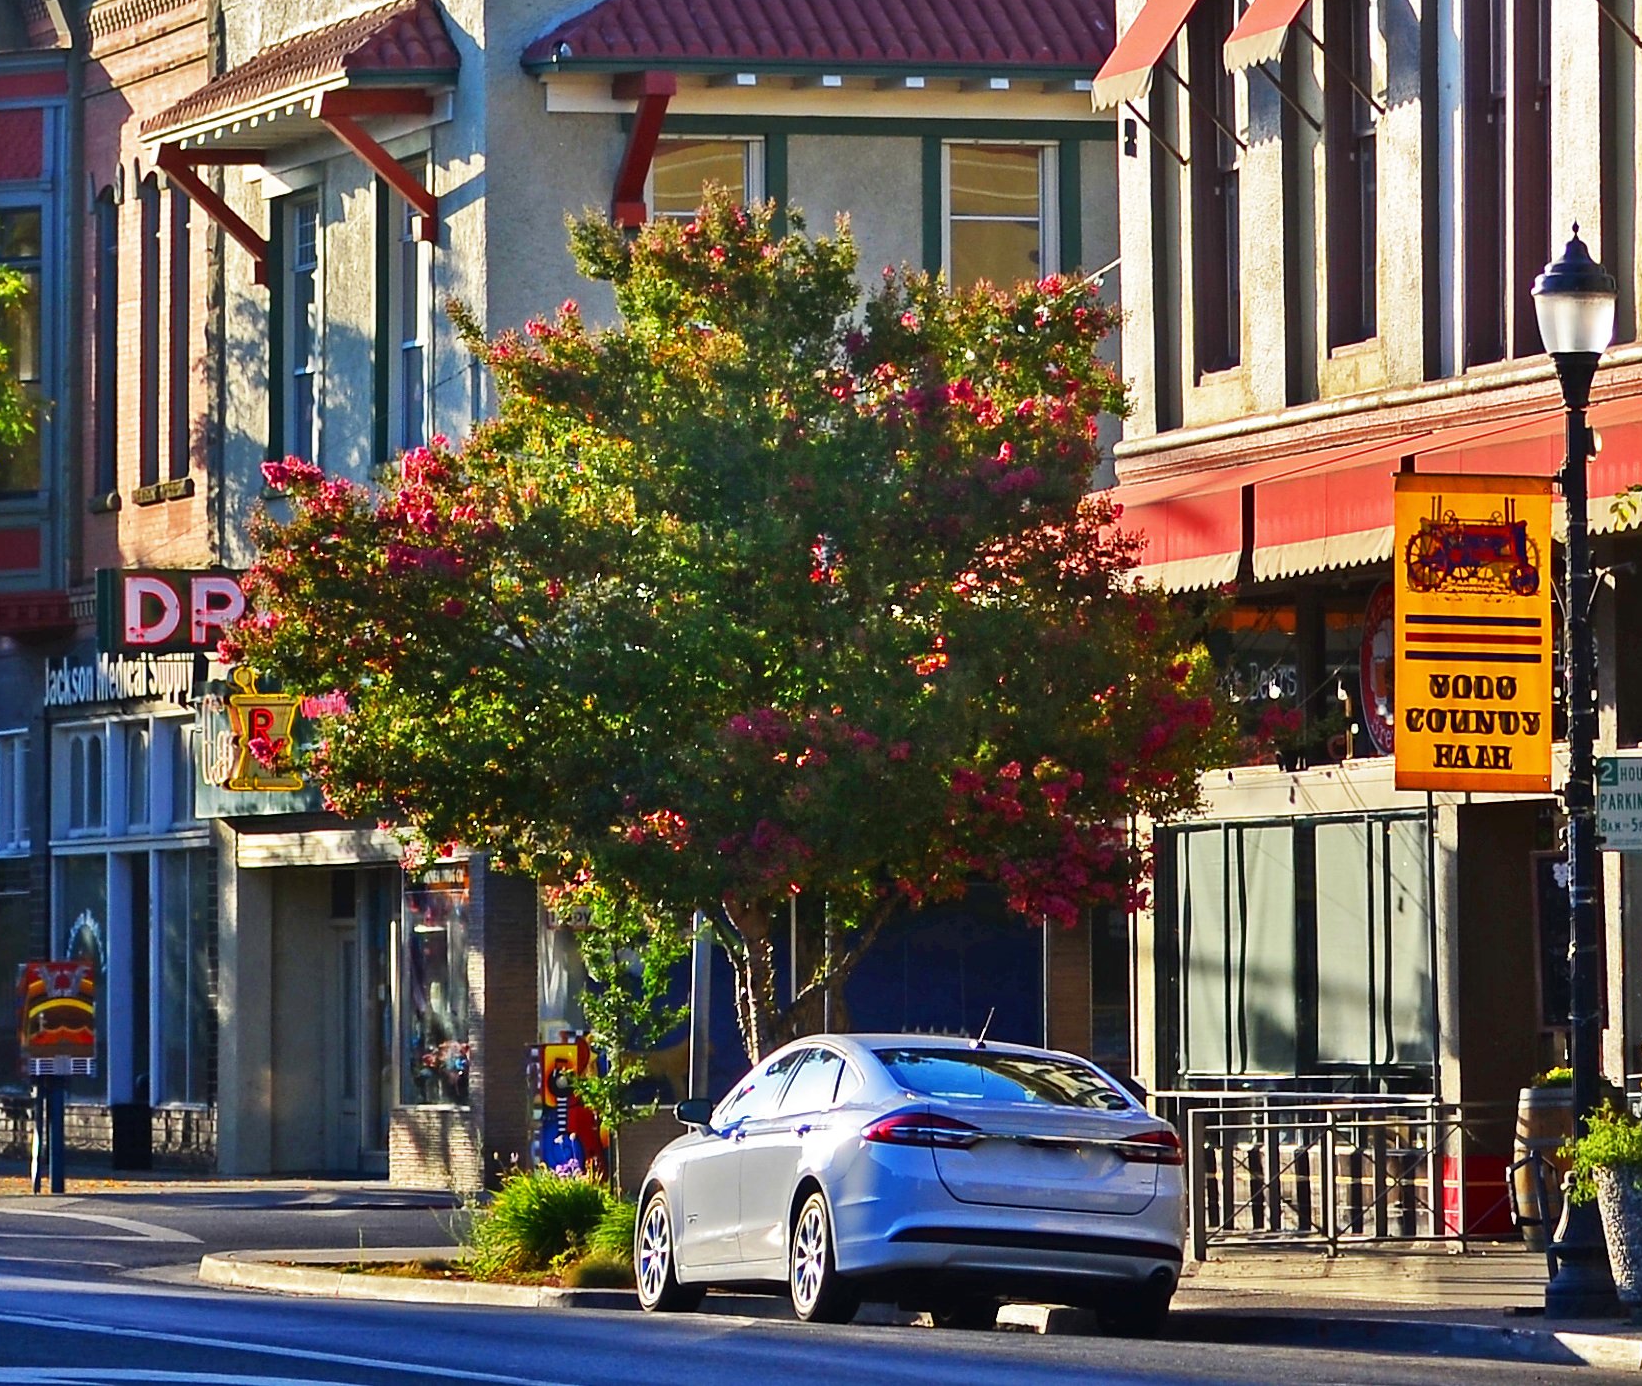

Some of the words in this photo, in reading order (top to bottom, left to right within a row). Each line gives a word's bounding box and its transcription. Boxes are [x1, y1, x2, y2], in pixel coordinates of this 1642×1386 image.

[44, 657, 95, 707] Jackson
[96, 652, 147, 701] Medical
[148, 652, 195, 704] Supply
[1600, 761, 1613, 782] 2
